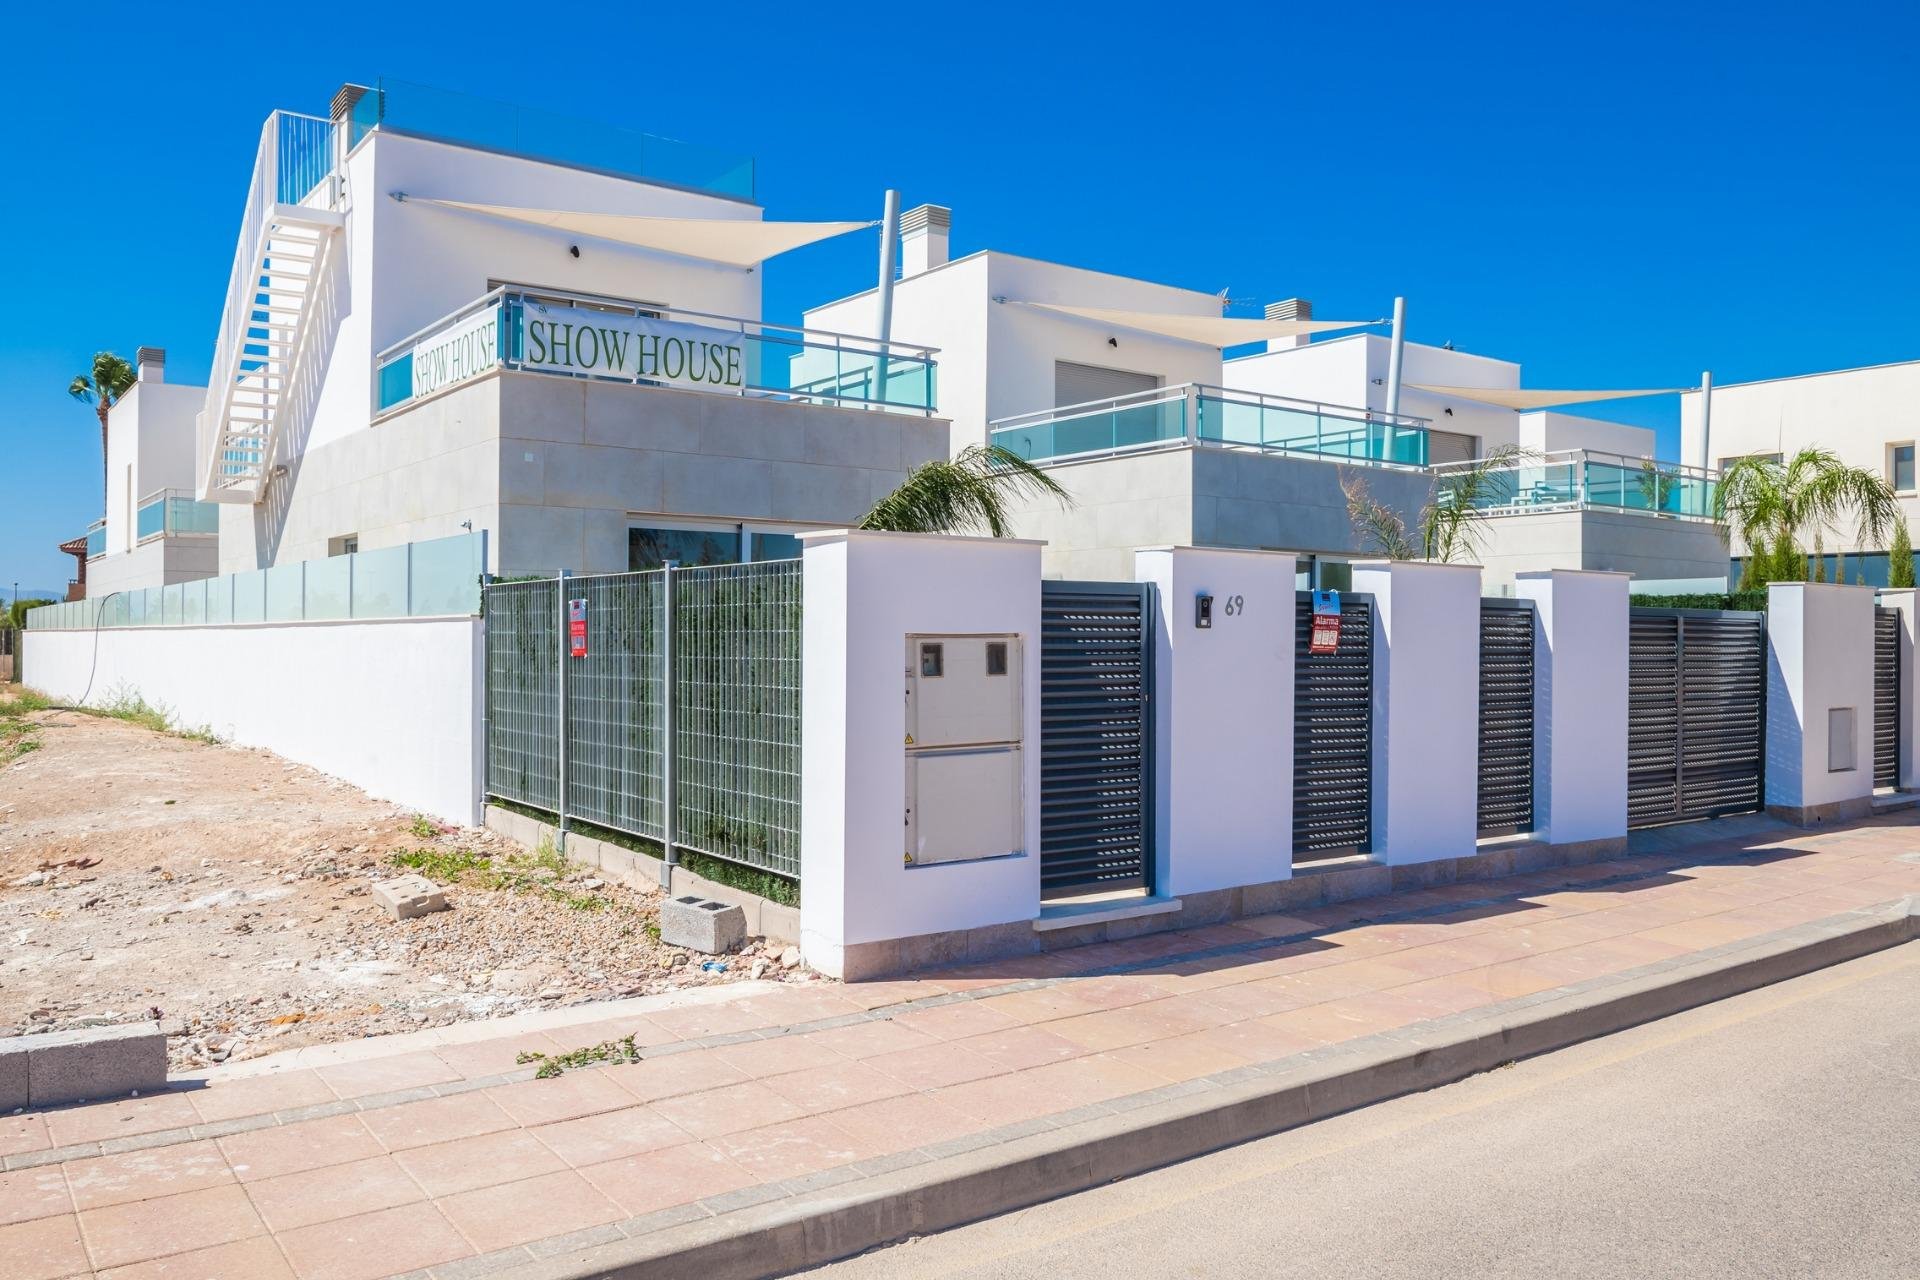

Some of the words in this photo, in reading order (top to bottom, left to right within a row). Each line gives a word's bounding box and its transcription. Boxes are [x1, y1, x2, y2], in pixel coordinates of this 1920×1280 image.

[415, 345, 448, 398] SHOW
[450, 320, 495, 383] HOUSE
[529, 320, 630, 372] SHOW
[637, 333, 741, 386] HOUSE
[1225, 595, 1244, 616] 69
[1315, 616, 1339, 625] Alarma
